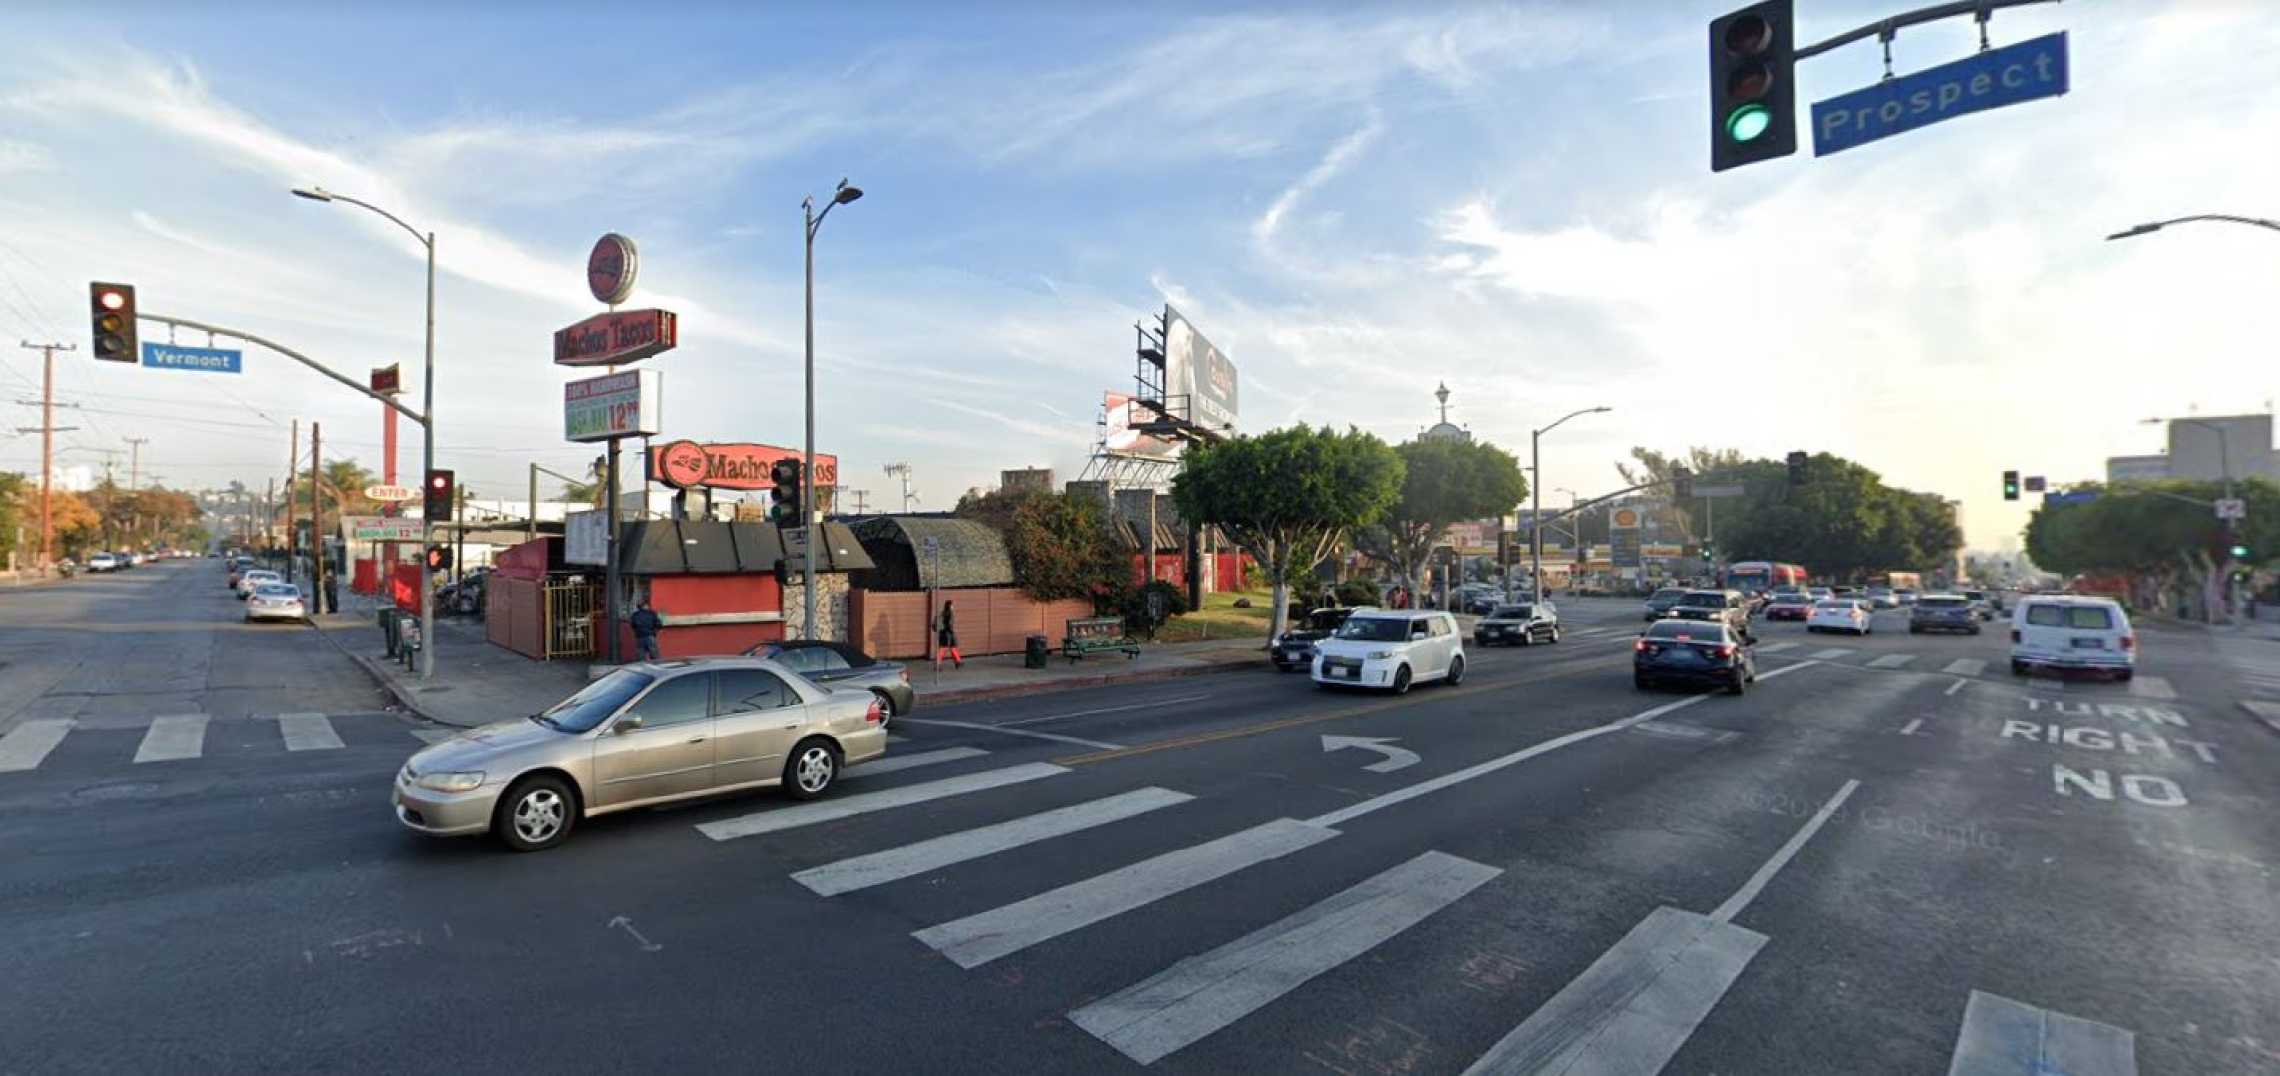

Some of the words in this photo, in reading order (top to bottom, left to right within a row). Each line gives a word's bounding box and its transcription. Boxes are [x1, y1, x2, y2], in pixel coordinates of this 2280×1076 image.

[1821, 50, 2054, 141] Prospect
[557, 328, 608, 357] Machos
[609, 316, 655, 346] Tacos
[153, 349, 230, 369] Vermont
[704, 453, 777, 480] Macho
[372, 487, 408, 497] ENTER
[2021, 696, 2190, 728] TURN
[2000, 719, 2220, 764] RIGHT
[2053, 762, 2189, 807] NO
